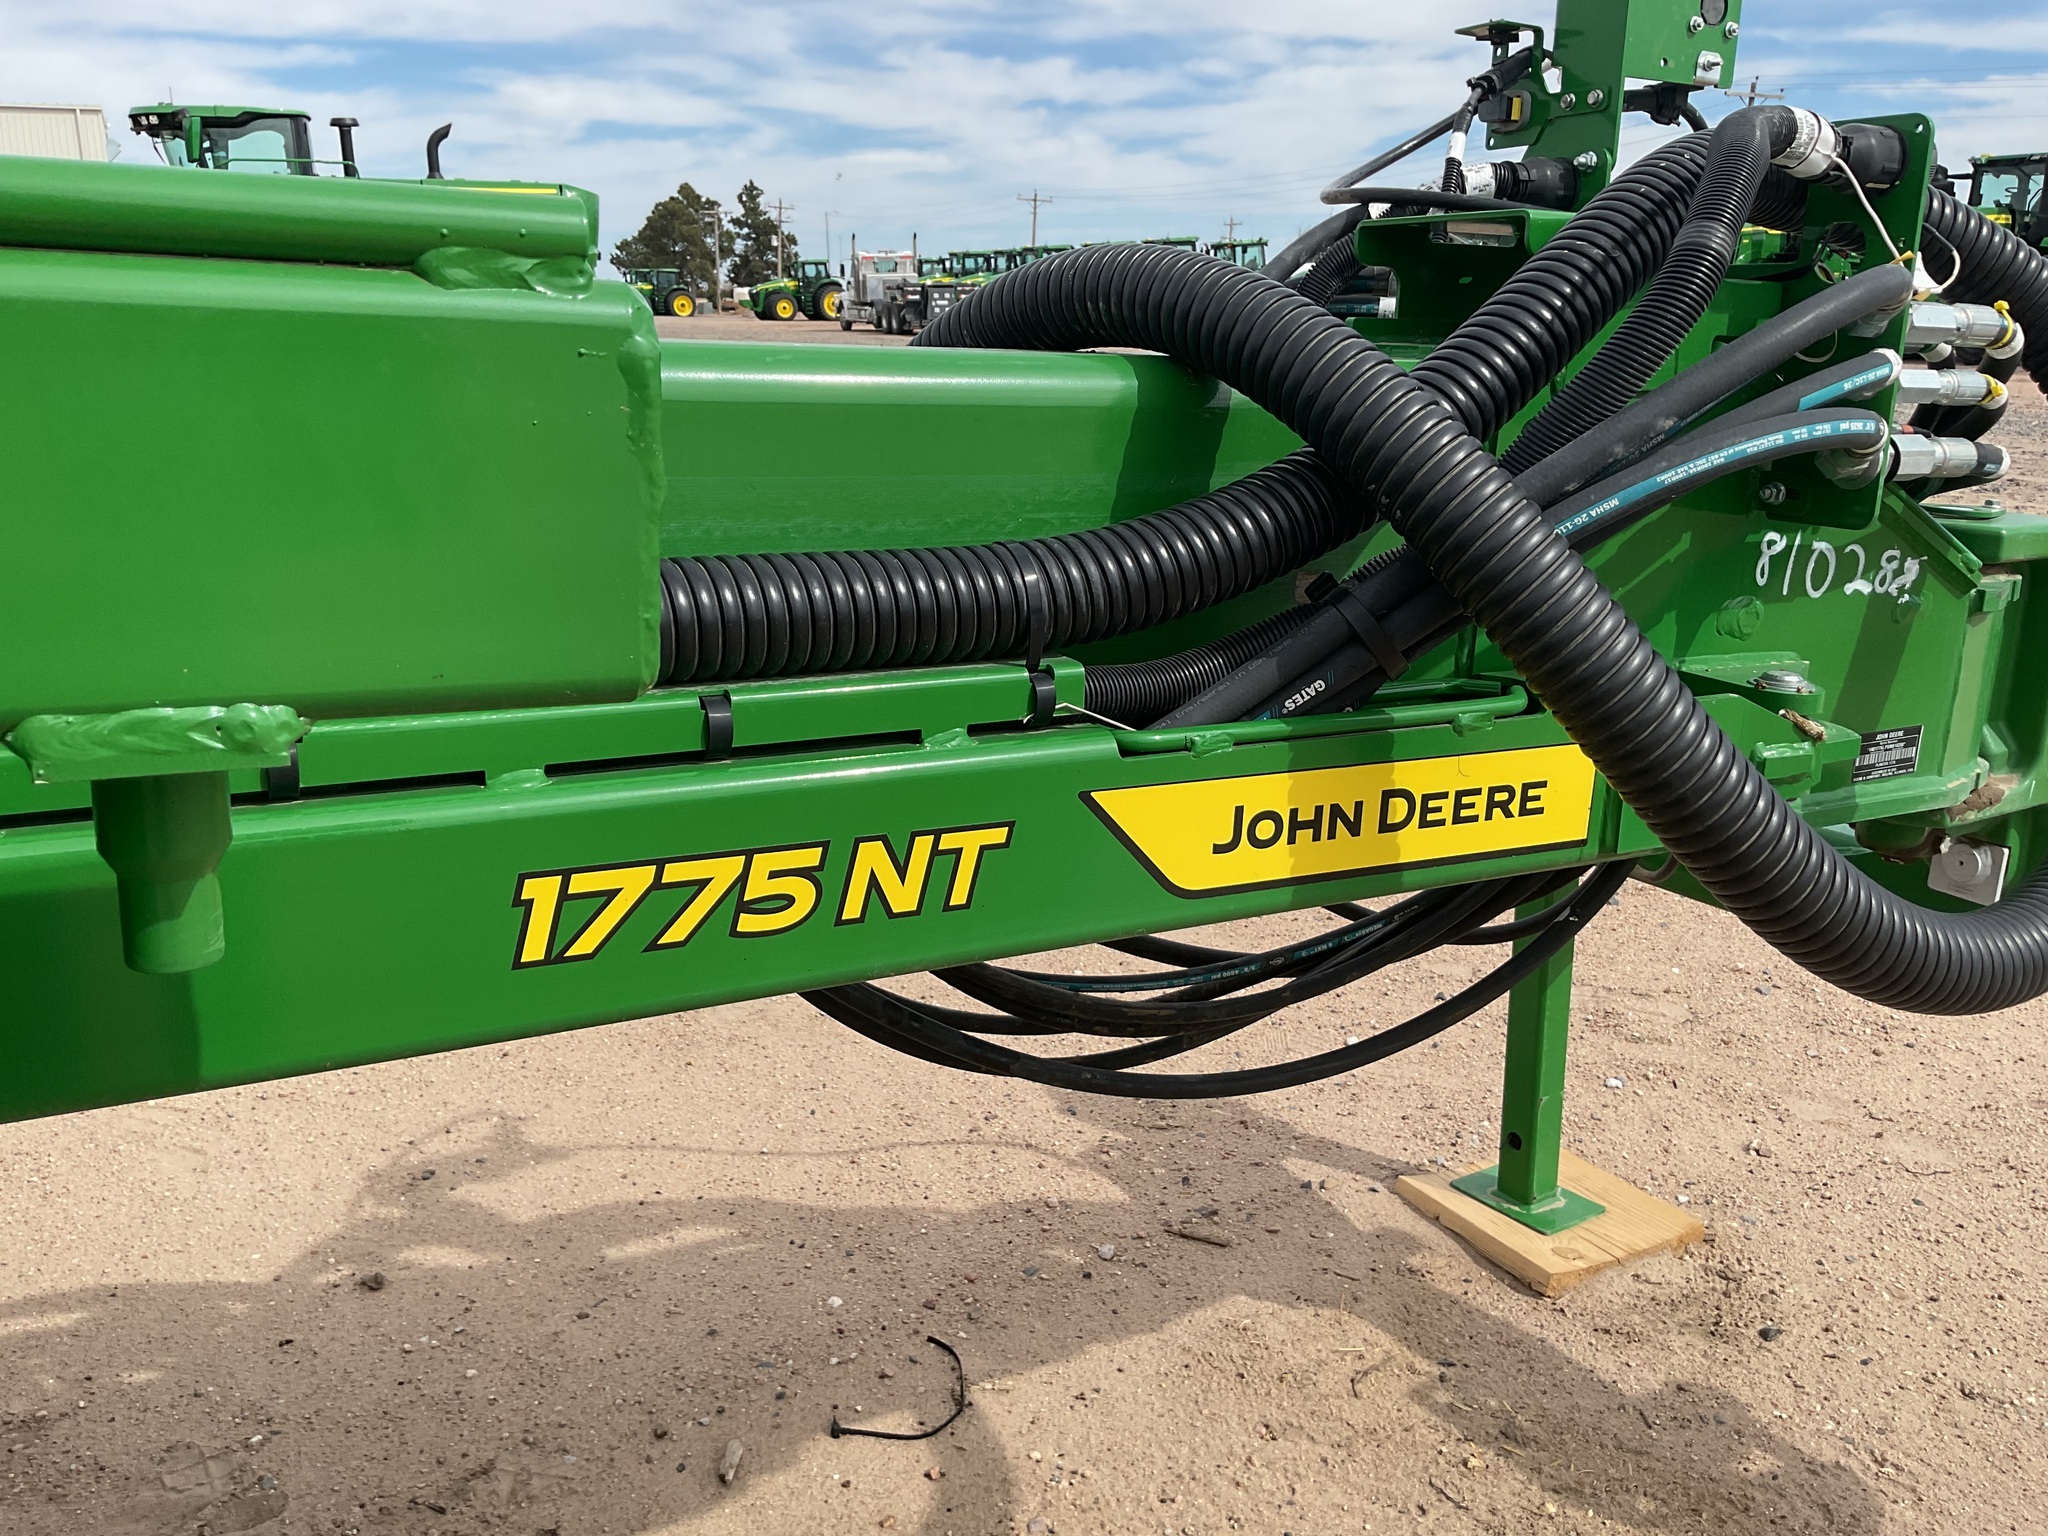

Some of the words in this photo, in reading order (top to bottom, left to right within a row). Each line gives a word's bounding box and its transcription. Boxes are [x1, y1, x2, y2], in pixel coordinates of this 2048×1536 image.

[1588, 497, 1620, 517] MSHA
[1212, 800, 1364, 855] JOHN
[1377, 780, 1548, 835] DEERE
[512, 839, 831, 970] 1775
[834, 820, 1016, 927] NT
